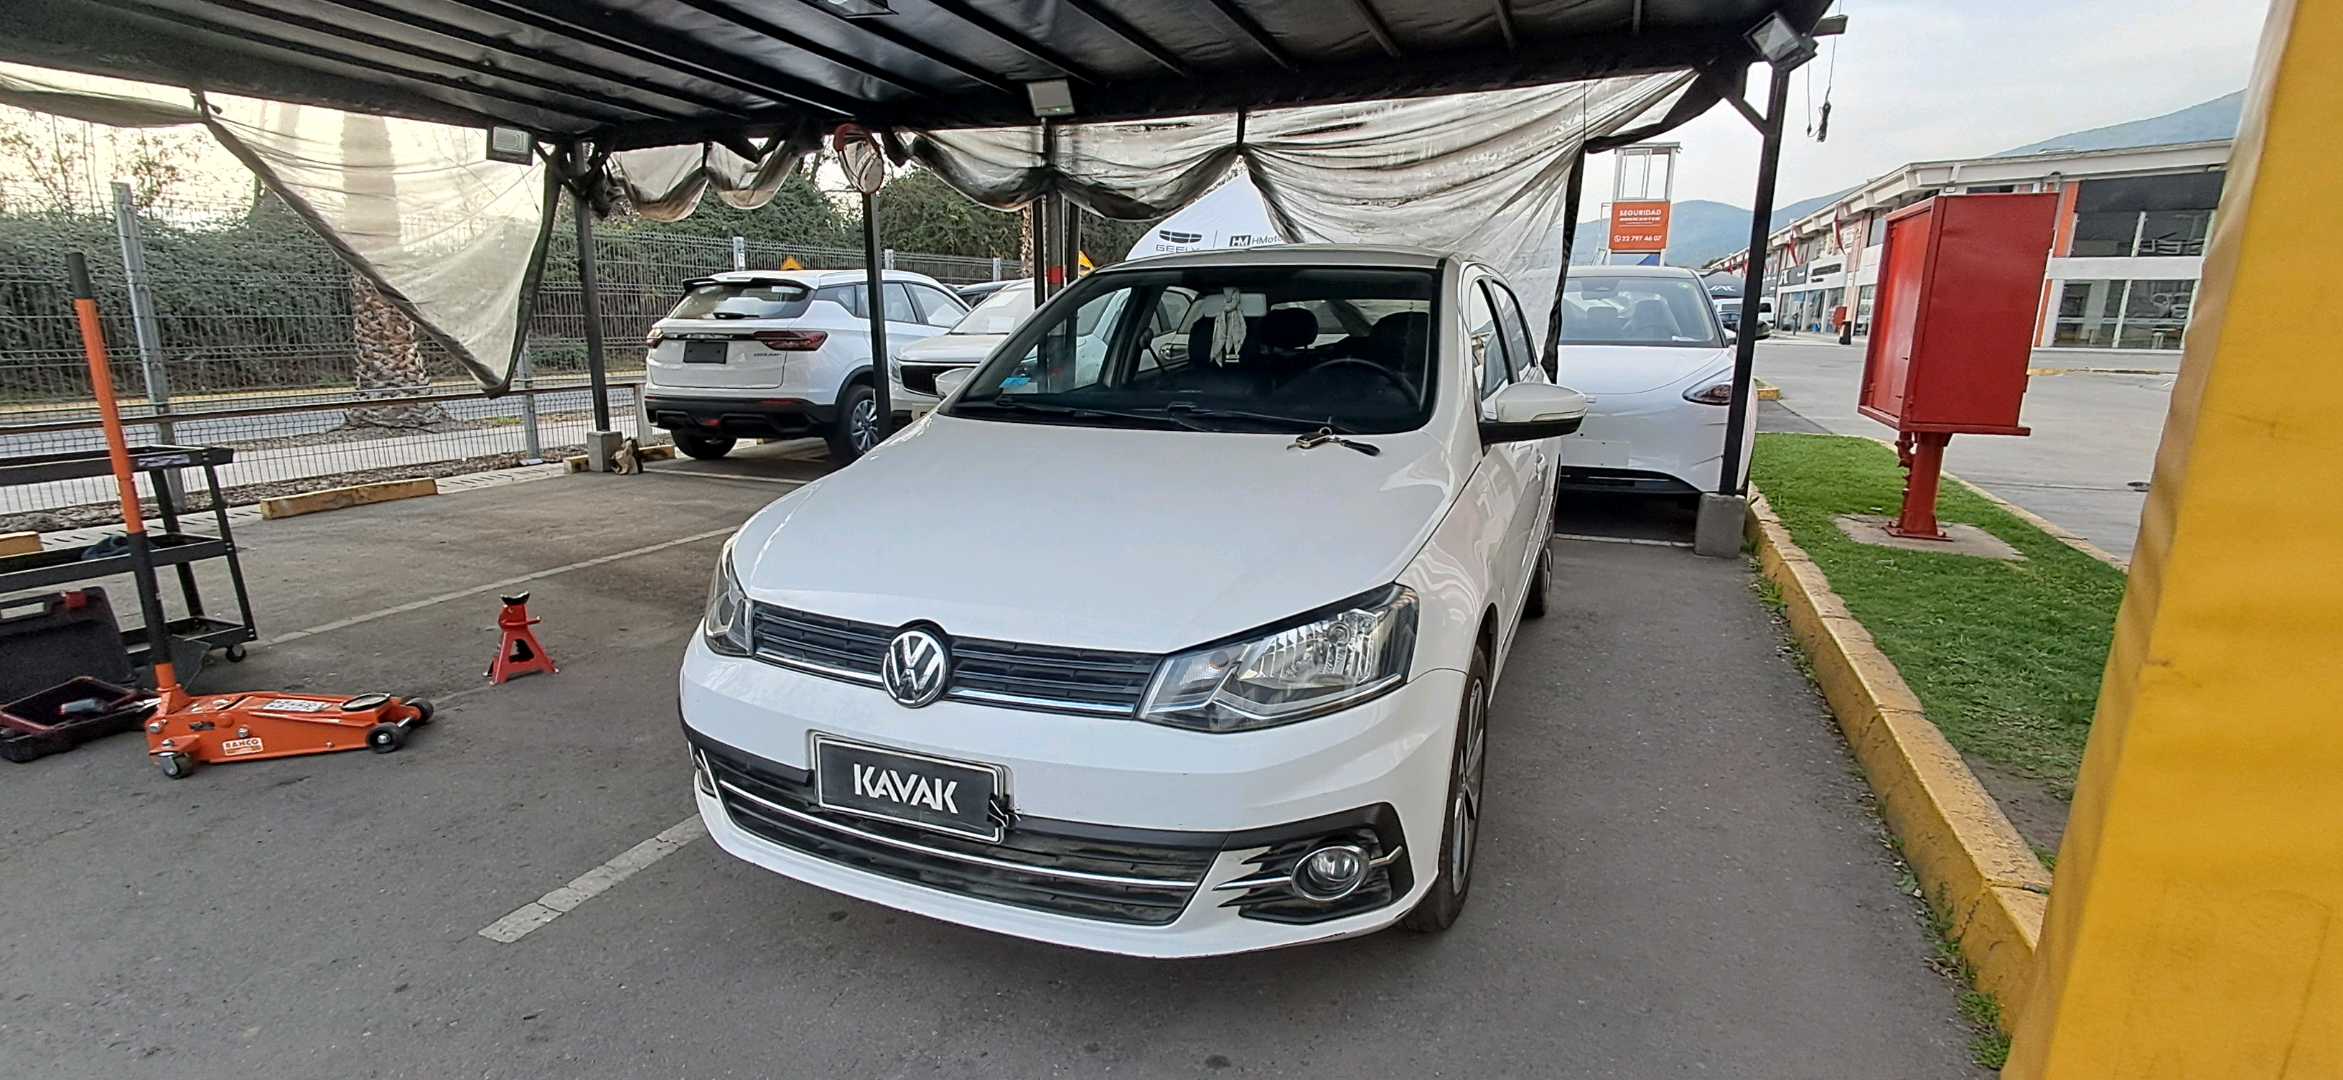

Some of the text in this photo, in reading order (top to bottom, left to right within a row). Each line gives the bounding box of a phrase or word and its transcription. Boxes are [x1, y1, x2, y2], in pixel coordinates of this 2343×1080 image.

[1619, 209, 1662, 217] SEGURIDAD
[1231, 236, 1250, 247] HM
[853, 763, 959, 814] KAVAK
